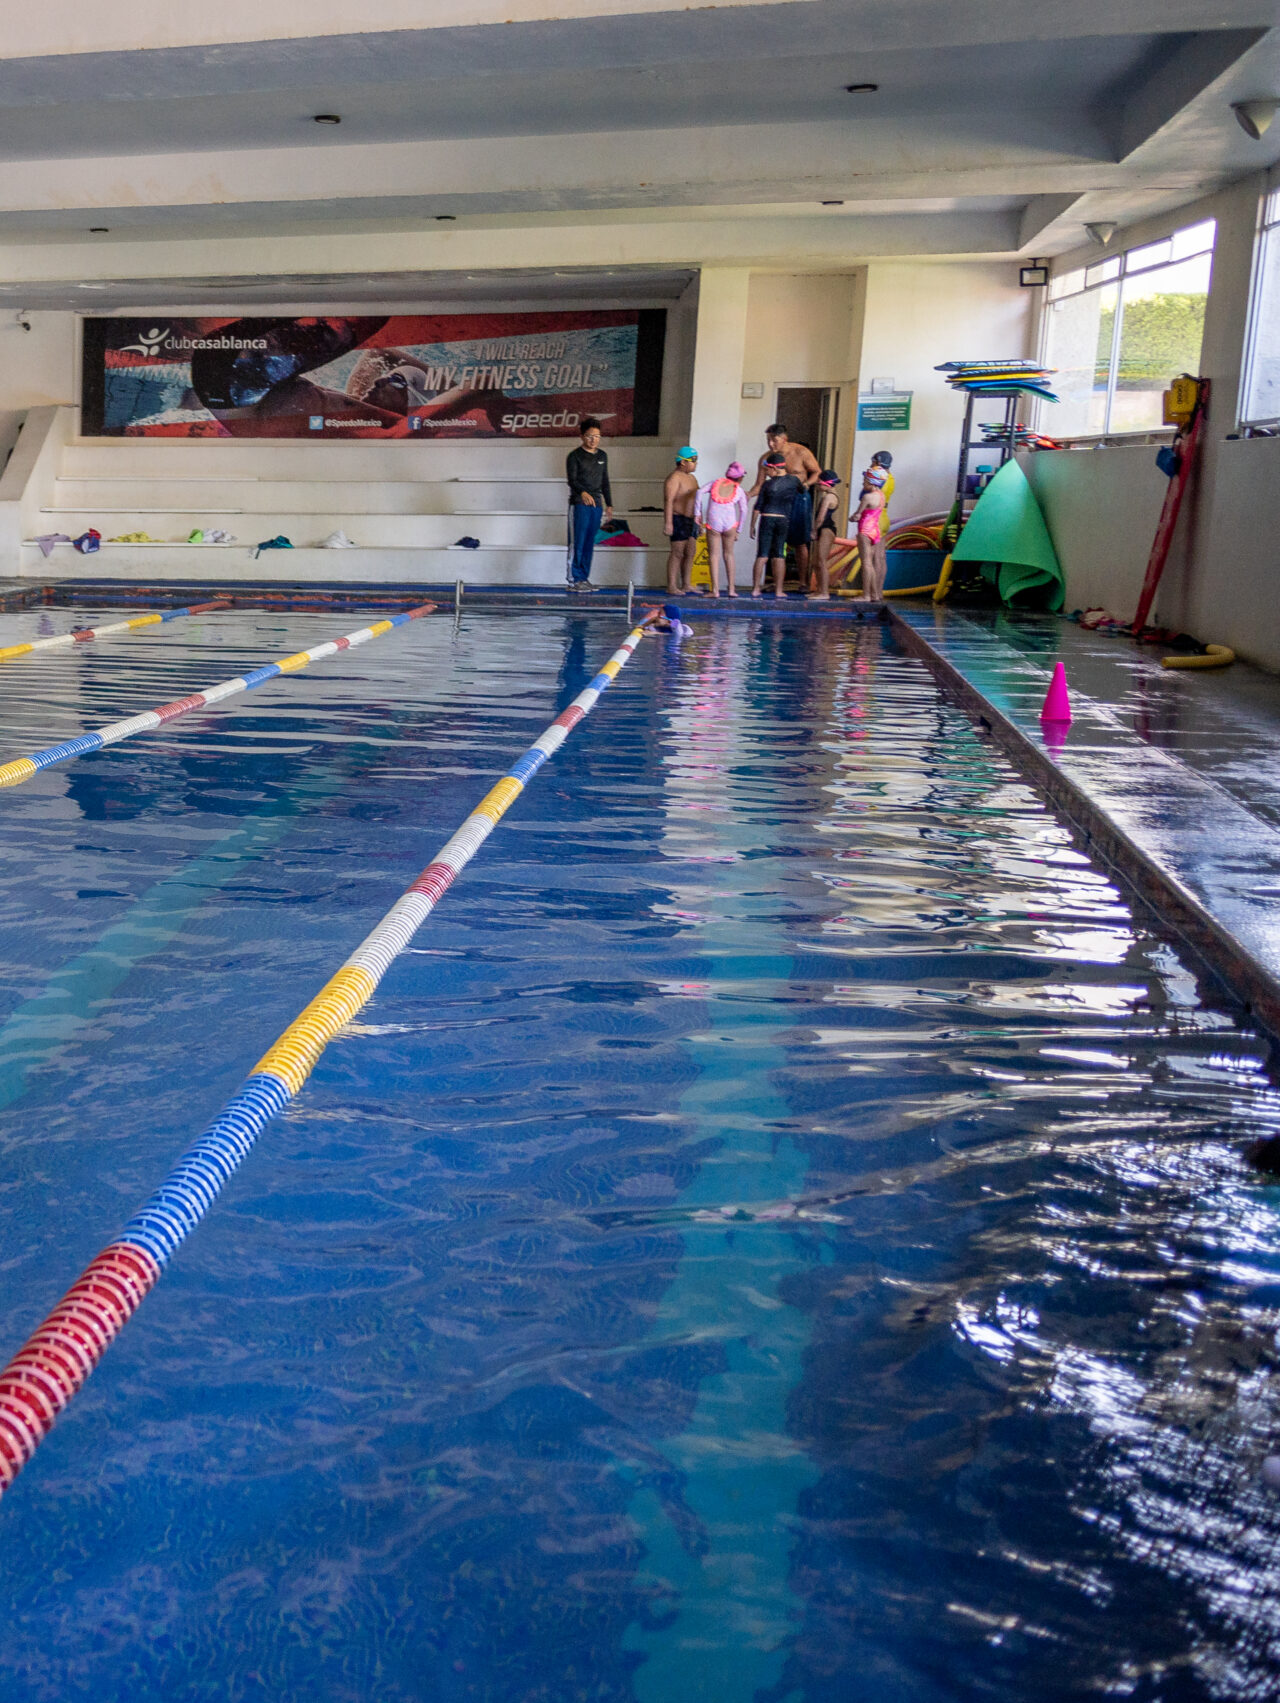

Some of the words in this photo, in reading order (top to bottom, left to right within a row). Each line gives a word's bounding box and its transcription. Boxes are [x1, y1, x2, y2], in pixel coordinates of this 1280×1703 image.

[164, 335, 268, 350] clubcasablanca
[484, 343, 520, 361] WILL
[521, 341, 567, 360] REACH
[423, 366, 458, 391] MY
[458, 364, 542, 391] FITNESS
[325, 418, 382, 428] @SpeedoMexico
[500, 409, 579, 432] speedo
